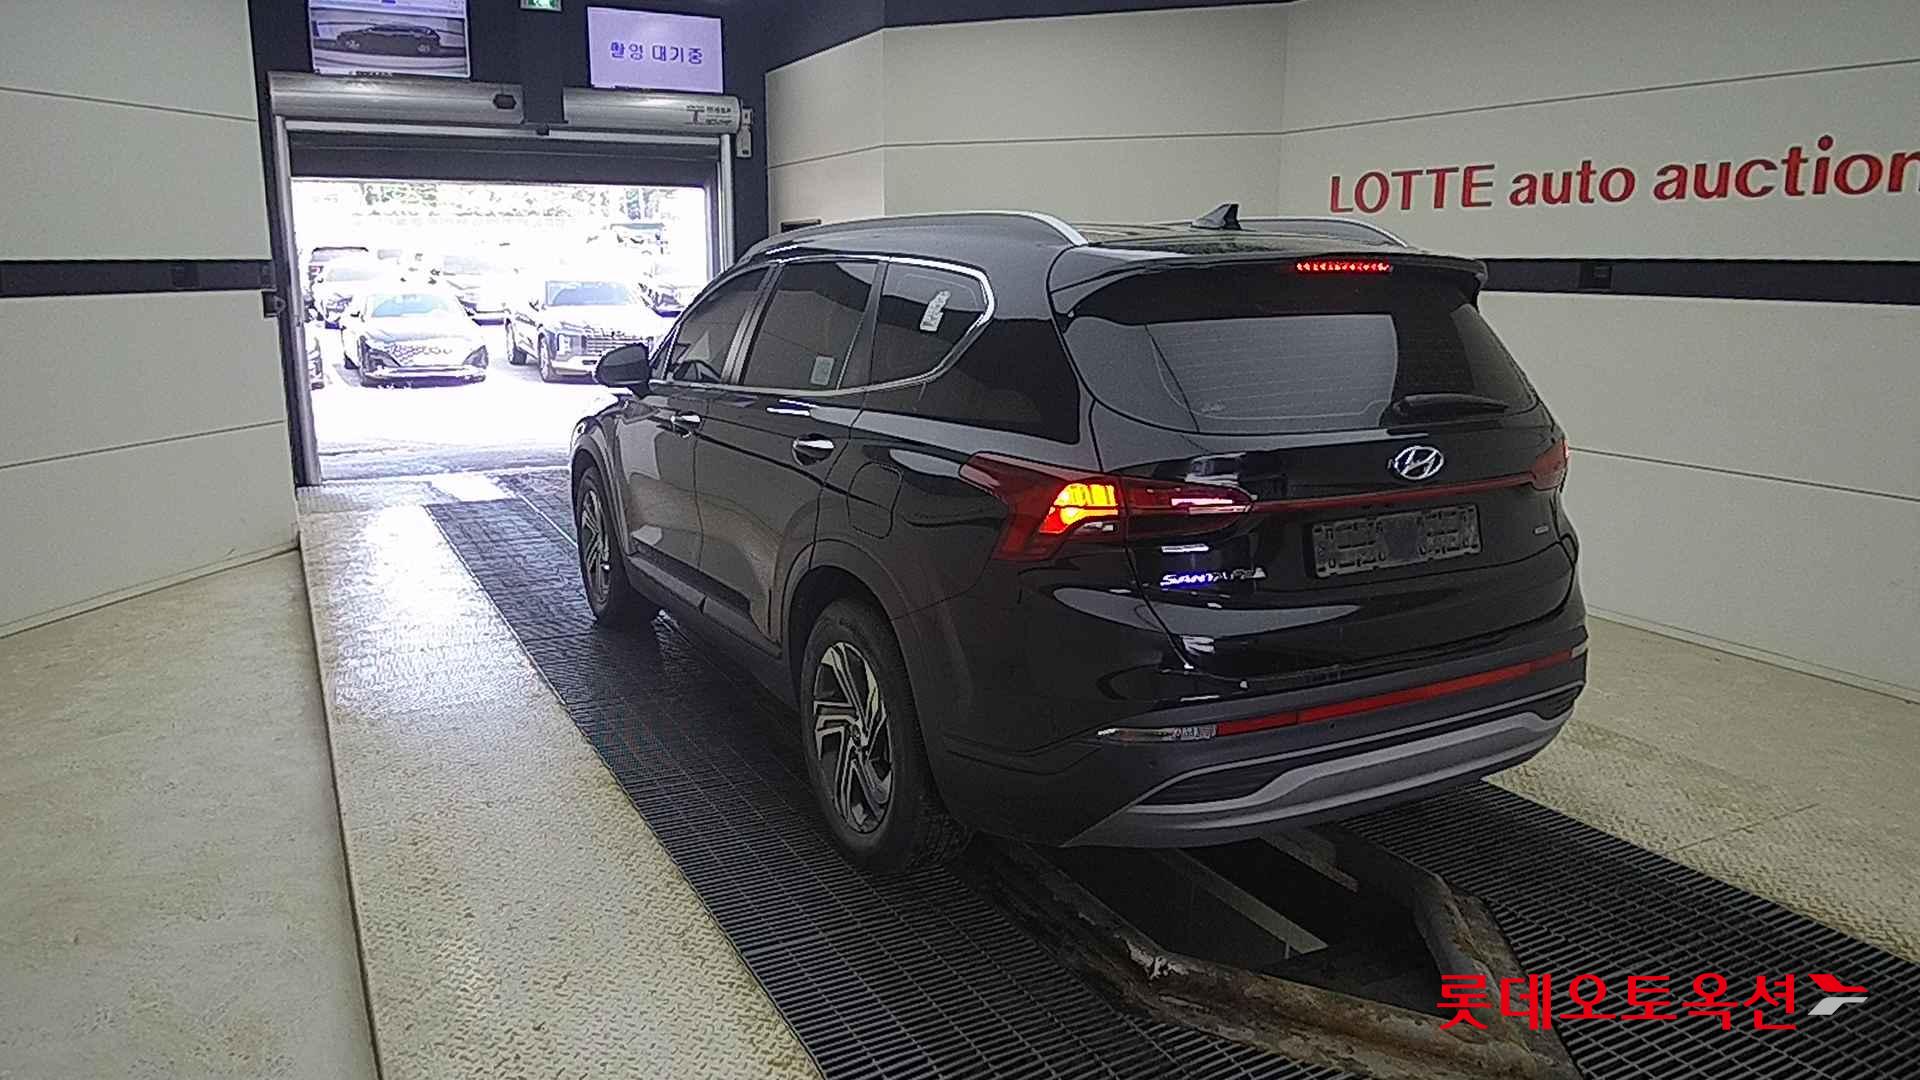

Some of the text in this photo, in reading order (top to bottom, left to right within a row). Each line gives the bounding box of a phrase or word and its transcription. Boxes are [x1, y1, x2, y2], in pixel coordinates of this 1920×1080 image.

[651, 44, 703, 65] 대기중
[1330, 134, 1920, 213] LOTTE auto auction
